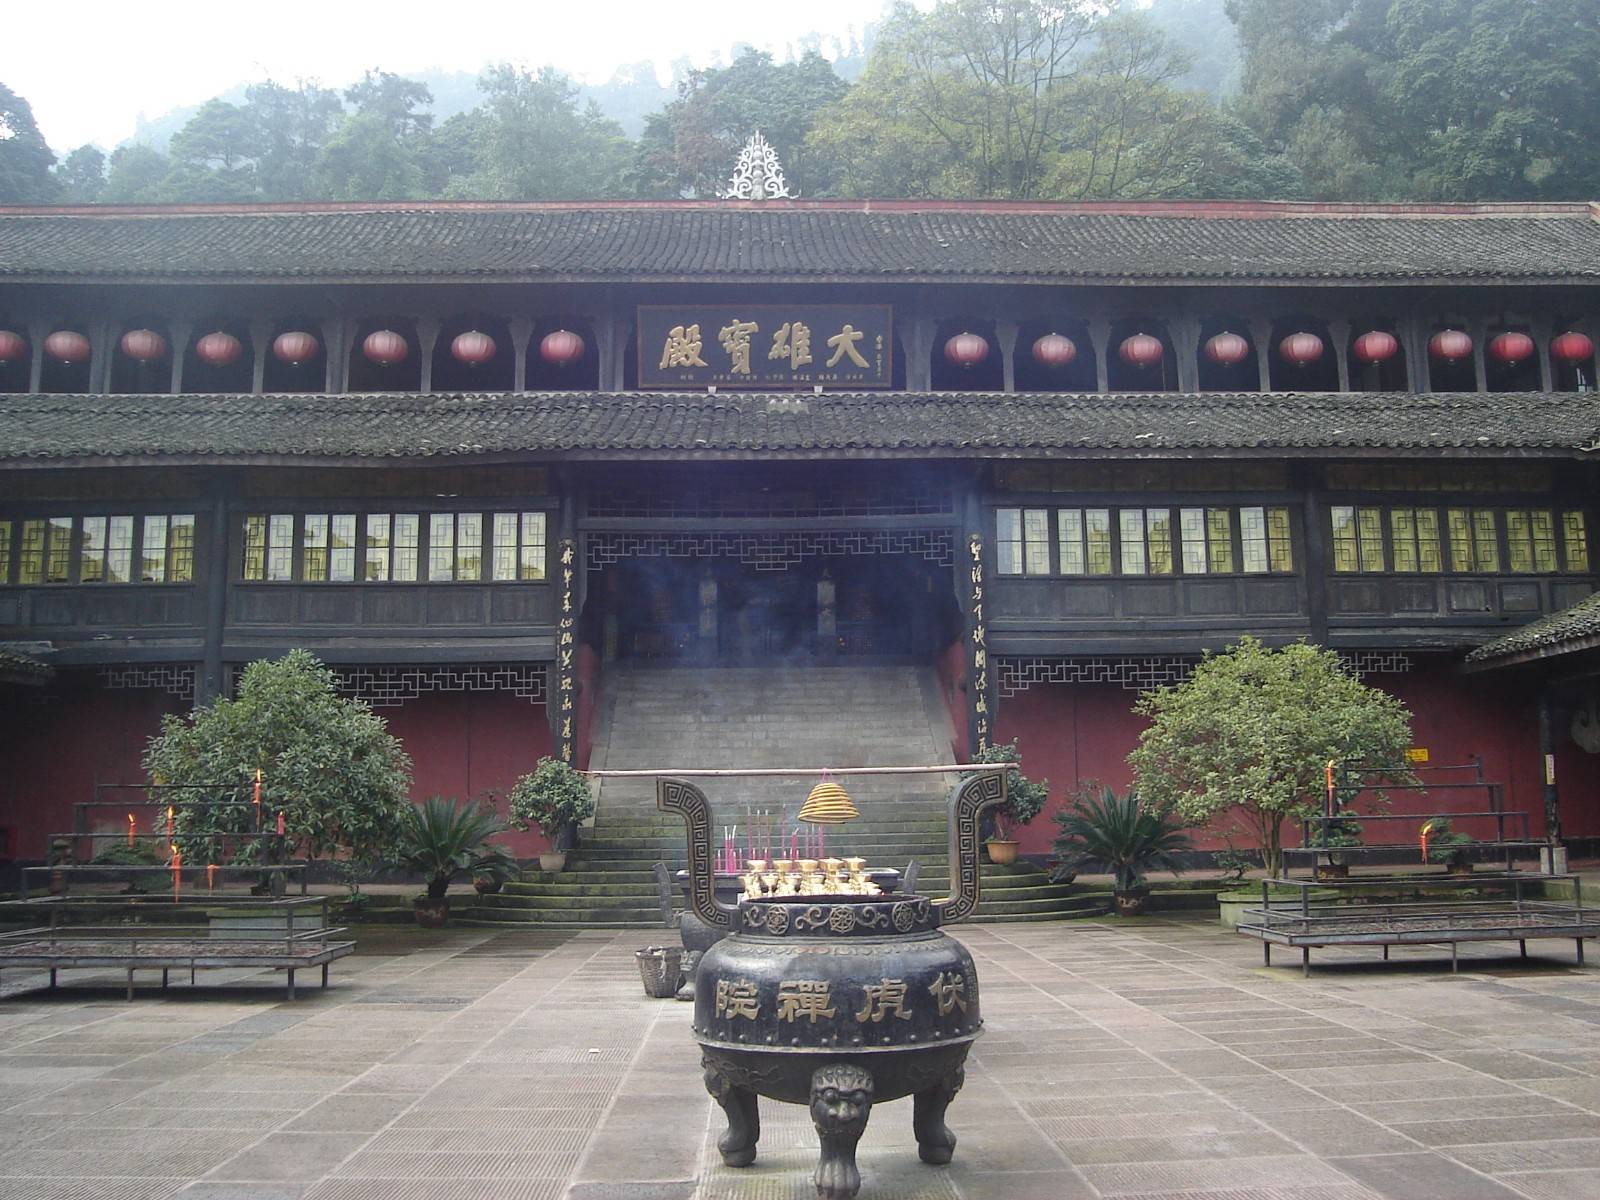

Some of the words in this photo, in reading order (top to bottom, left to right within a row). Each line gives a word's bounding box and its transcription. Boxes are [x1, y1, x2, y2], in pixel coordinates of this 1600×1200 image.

[659, 318, 870, 374] 大雄寶殿
[716, 971, 967, 1024] 伏虎禪院
